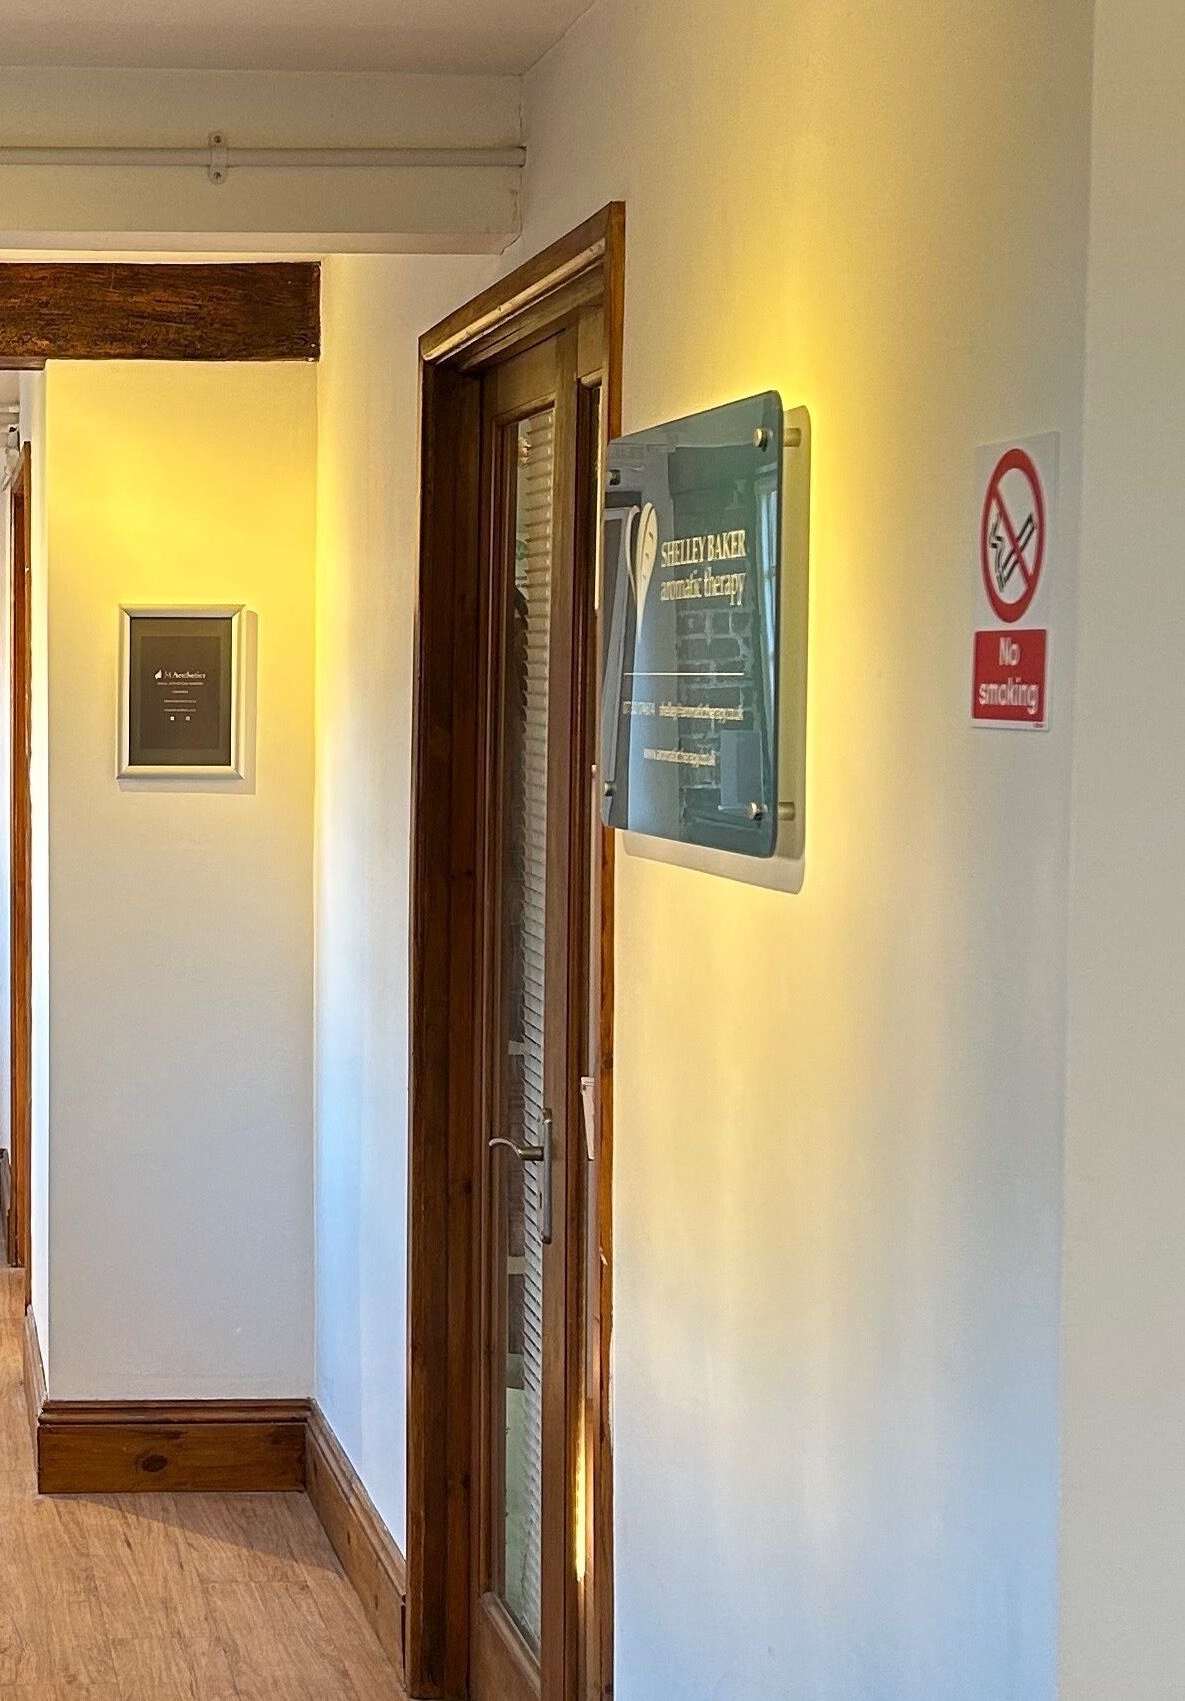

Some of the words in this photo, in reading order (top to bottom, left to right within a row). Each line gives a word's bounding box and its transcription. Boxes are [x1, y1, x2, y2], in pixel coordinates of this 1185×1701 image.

[661, 536, 706, 568] SHELLEY
[707, 530, 746, 562] BAKER
[660, 569, 703, 601] aromatic
[704, 566, 746, 606] therapy
[999, 637, 1020, 666] No
[978, 677, 1039, 715] smoking
